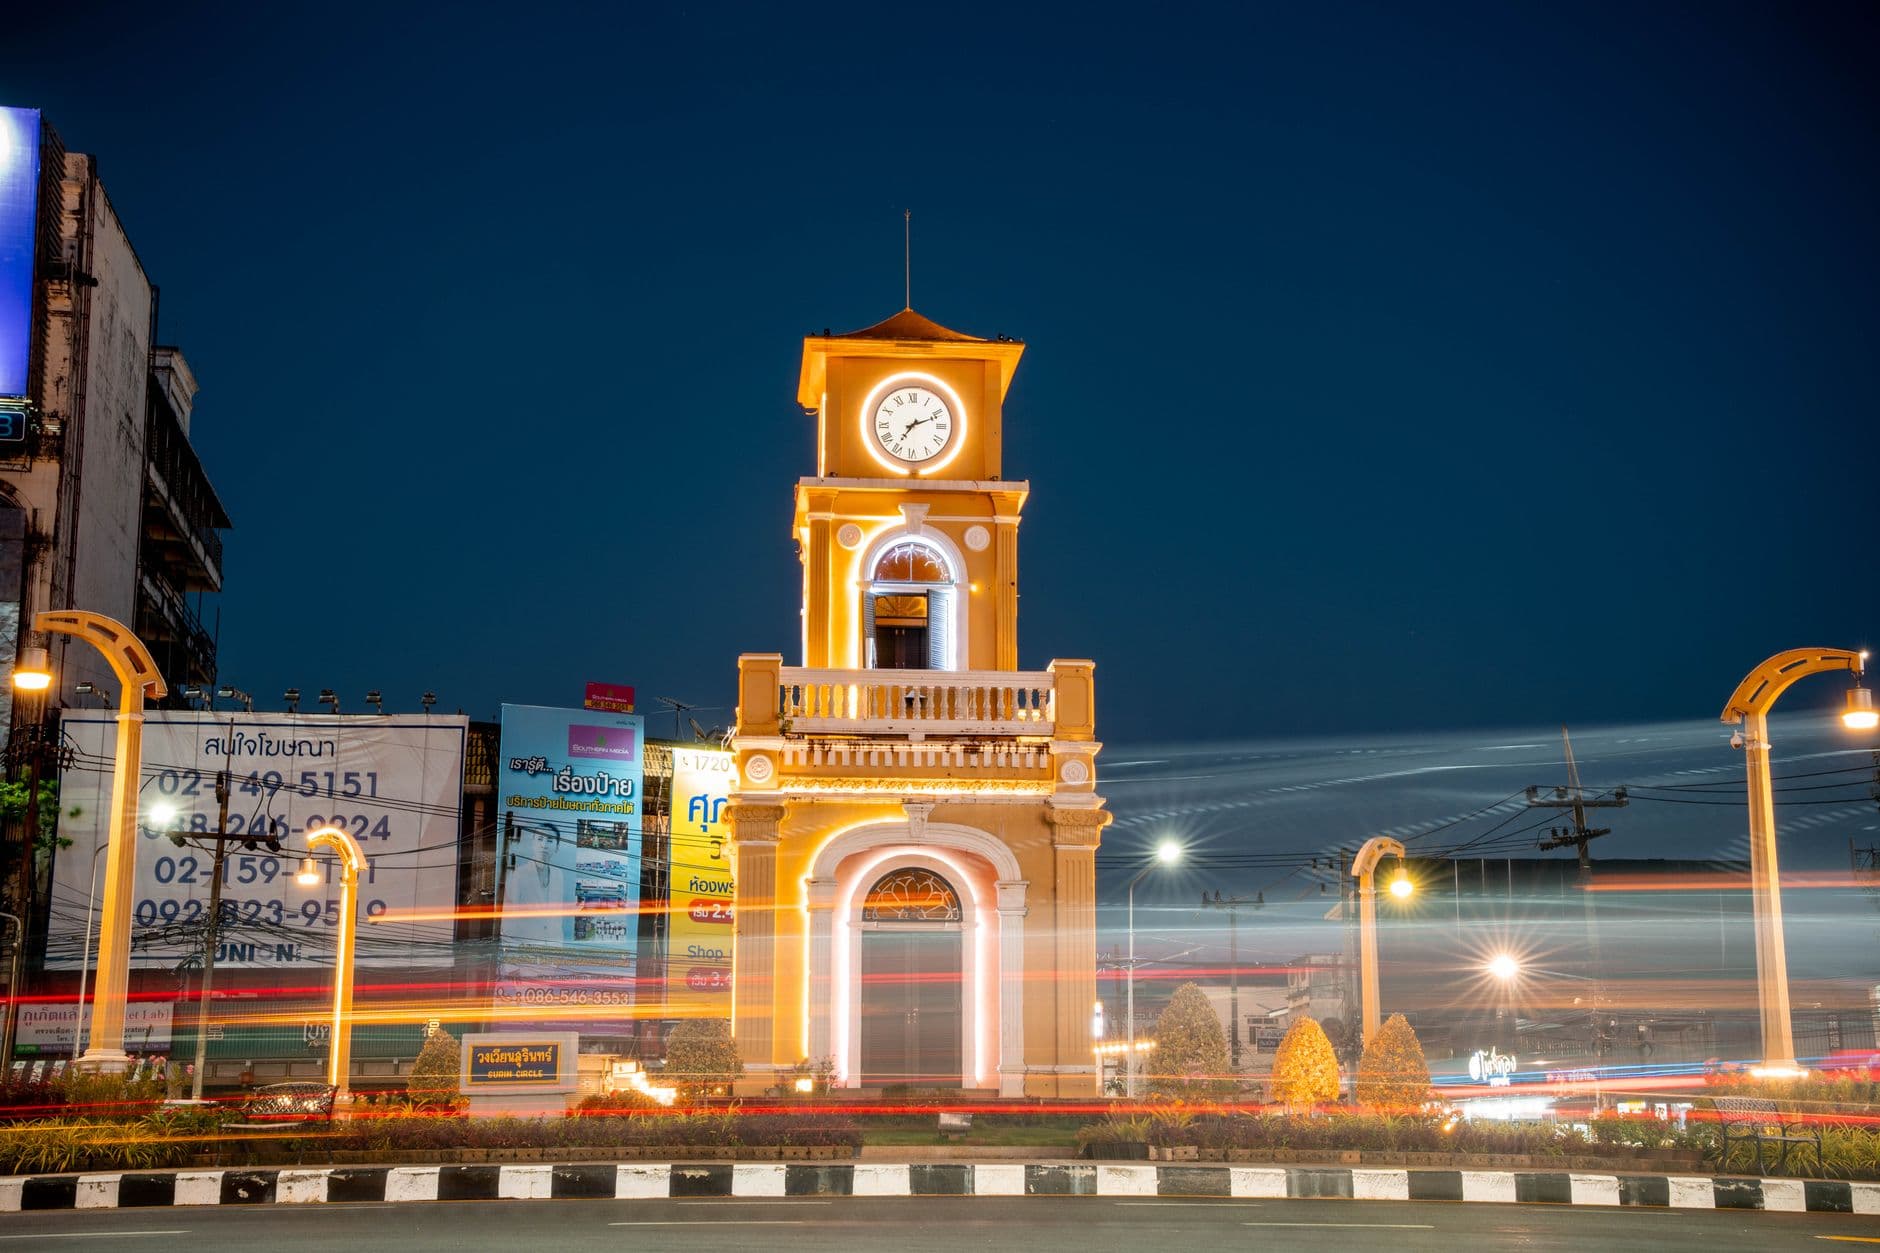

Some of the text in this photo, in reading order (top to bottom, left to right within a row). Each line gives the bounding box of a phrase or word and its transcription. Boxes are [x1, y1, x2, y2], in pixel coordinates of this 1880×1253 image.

[205, 732, 335, 757] สนใจโฆษณา
[695, 755, 730, 772] 1720
[552, 766, 633, 796] เรื่องป้าย
[155, 856, 376, 884] 02-159-11
[688, 945, 723, 961] Shop
[525, 987, 629, 1005] 086-546-3553
[477, 1046, 553, 1068] วงเวียนสุรินทร์
[515, 1069, 544, 1079] CIRCLE
